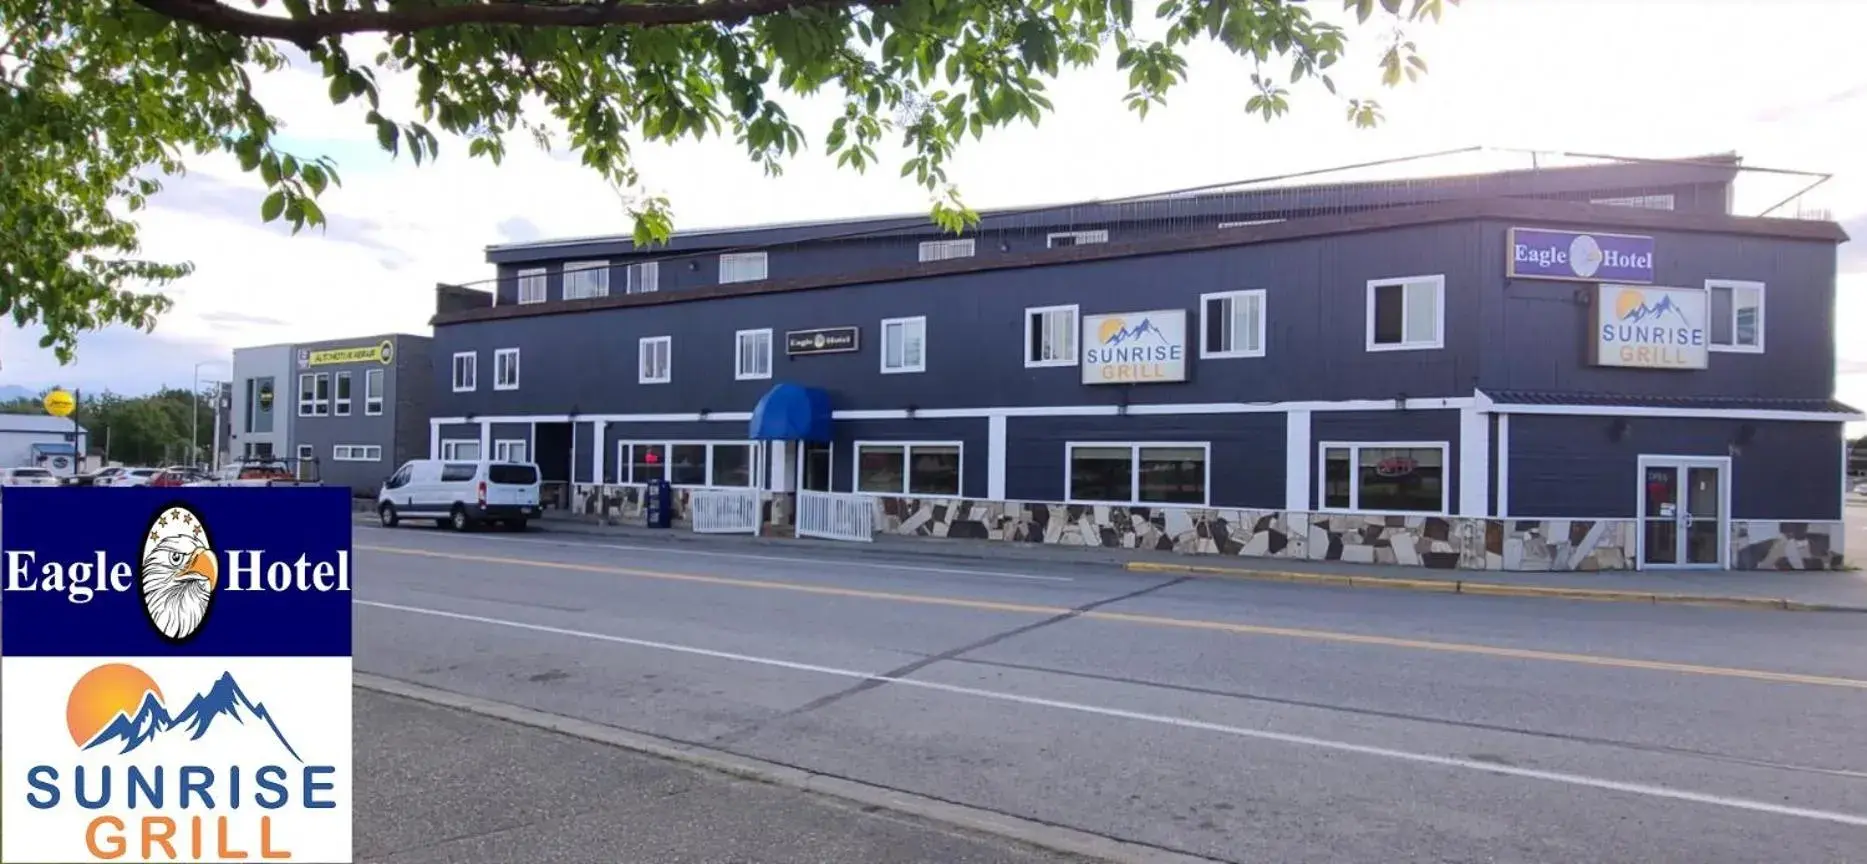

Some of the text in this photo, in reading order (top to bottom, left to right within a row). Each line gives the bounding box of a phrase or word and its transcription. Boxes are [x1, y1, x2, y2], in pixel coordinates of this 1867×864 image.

[1515, 244, 1653, 268] Eagle Hotel
[790, 336, 851, 347] Eagle Hotel
[1603, 324, 1703, 346] SUNRISE
[1088, 345, 1181, 363] SUNRISE
[1620, 346, 1687, 364] GRILL
[1102, 364, 1164, 379] GRILL
